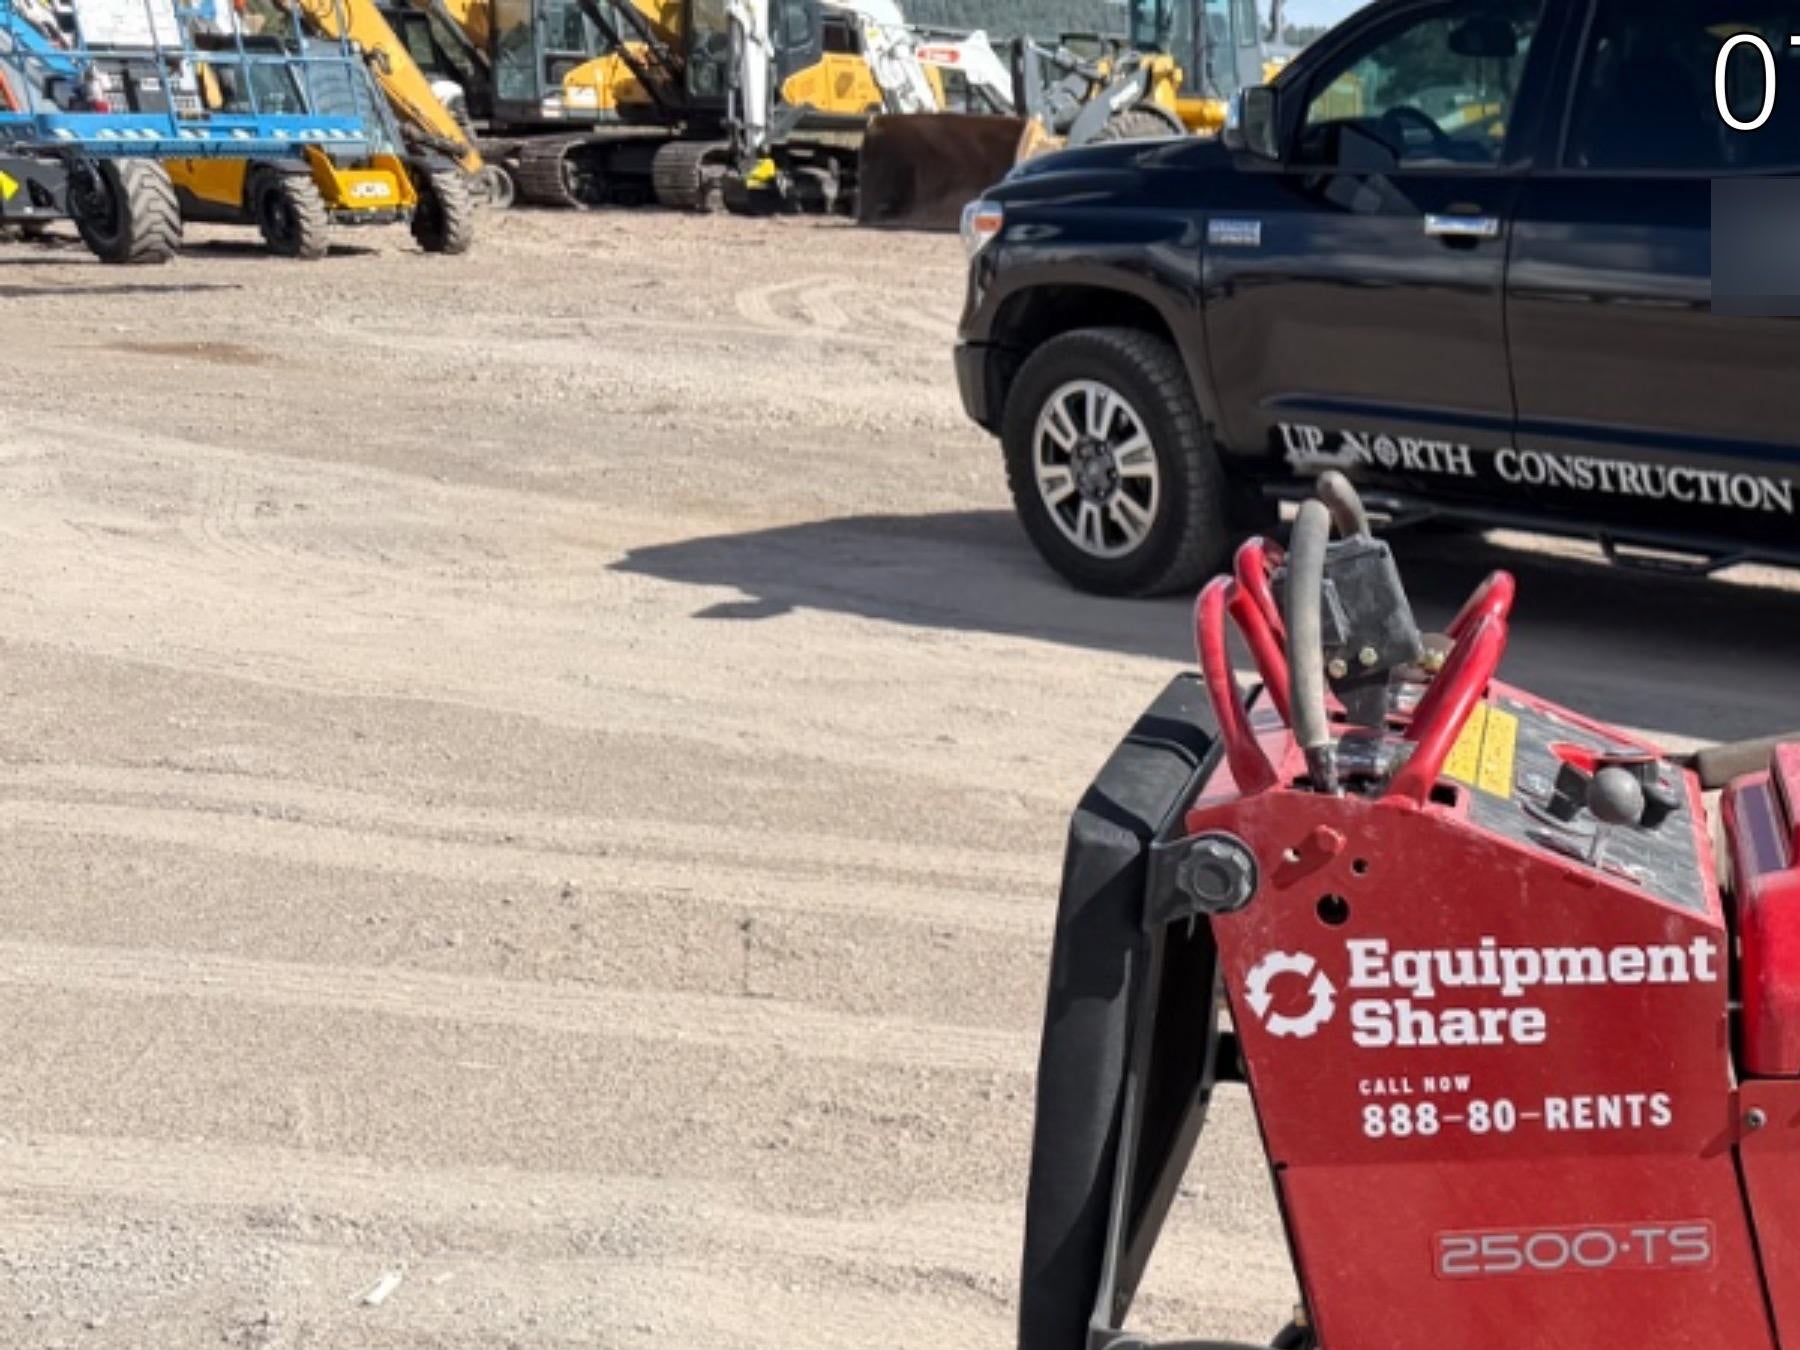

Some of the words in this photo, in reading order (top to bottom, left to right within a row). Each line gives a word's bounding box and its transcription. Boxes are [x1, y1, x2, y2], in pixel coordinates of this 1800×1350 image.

[1494, 448, 1794, 514] CONSTRUCTION
[1346, 936, 1718, 997] Equipment
[1350, 998, 1547, 1048] Share
[1358, 1076, 1414, 1096] CALL
[1423, 1074, 1471, 1094] NOW
[1362, 1092, 1673, 1139] 888-80-RENTS
